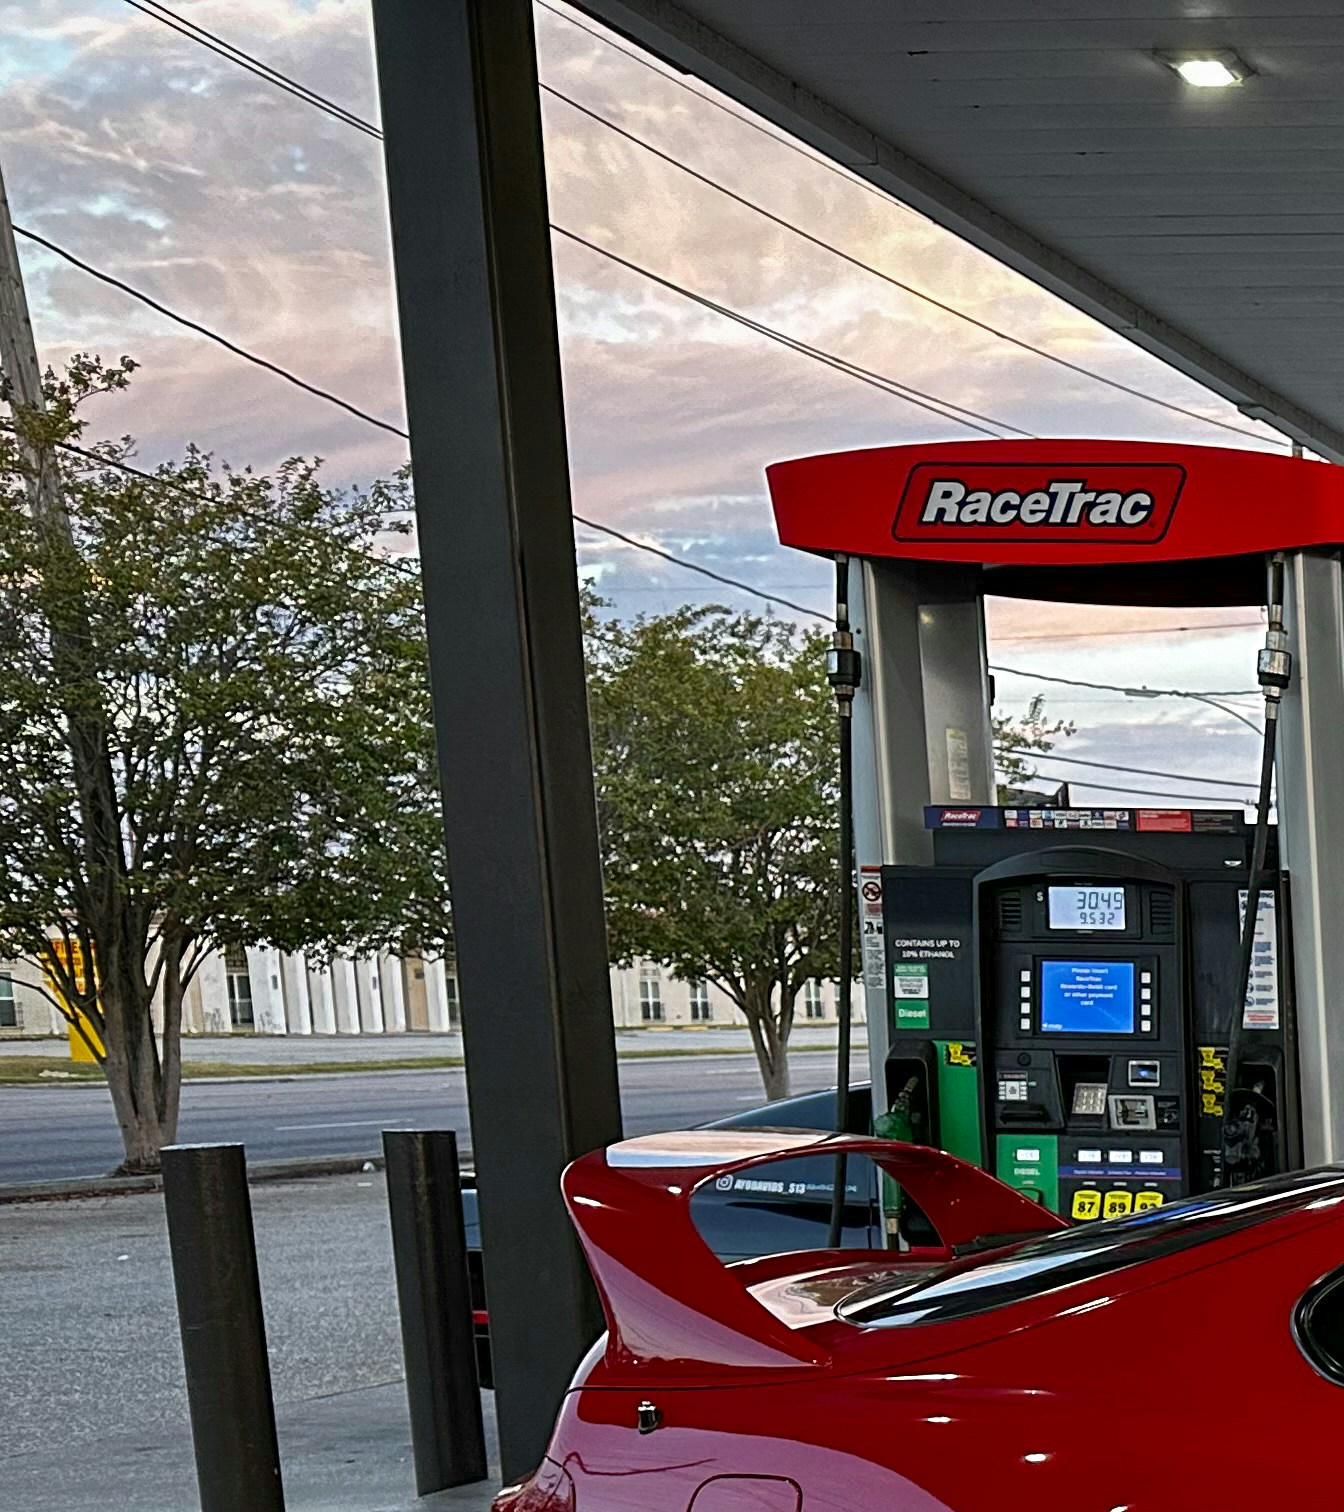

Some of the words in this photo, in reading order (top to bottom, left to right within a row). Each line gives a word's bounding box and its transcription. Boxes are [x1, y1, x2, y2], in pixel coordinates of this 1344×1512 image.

[921, 480, 1151, 524] RaceTrac
[895, 939, 935, 948] CONTAINS
[936, 939, 948, 948] UP
[949, 940, 961, 948] TO
[919, 950, 955, 959] ETHANOL
[898, 1008, 926, 1018] Diesel
[1077, 1200, 1095, 1213] 87
[1108, 1201, 1126, 1213] 89
